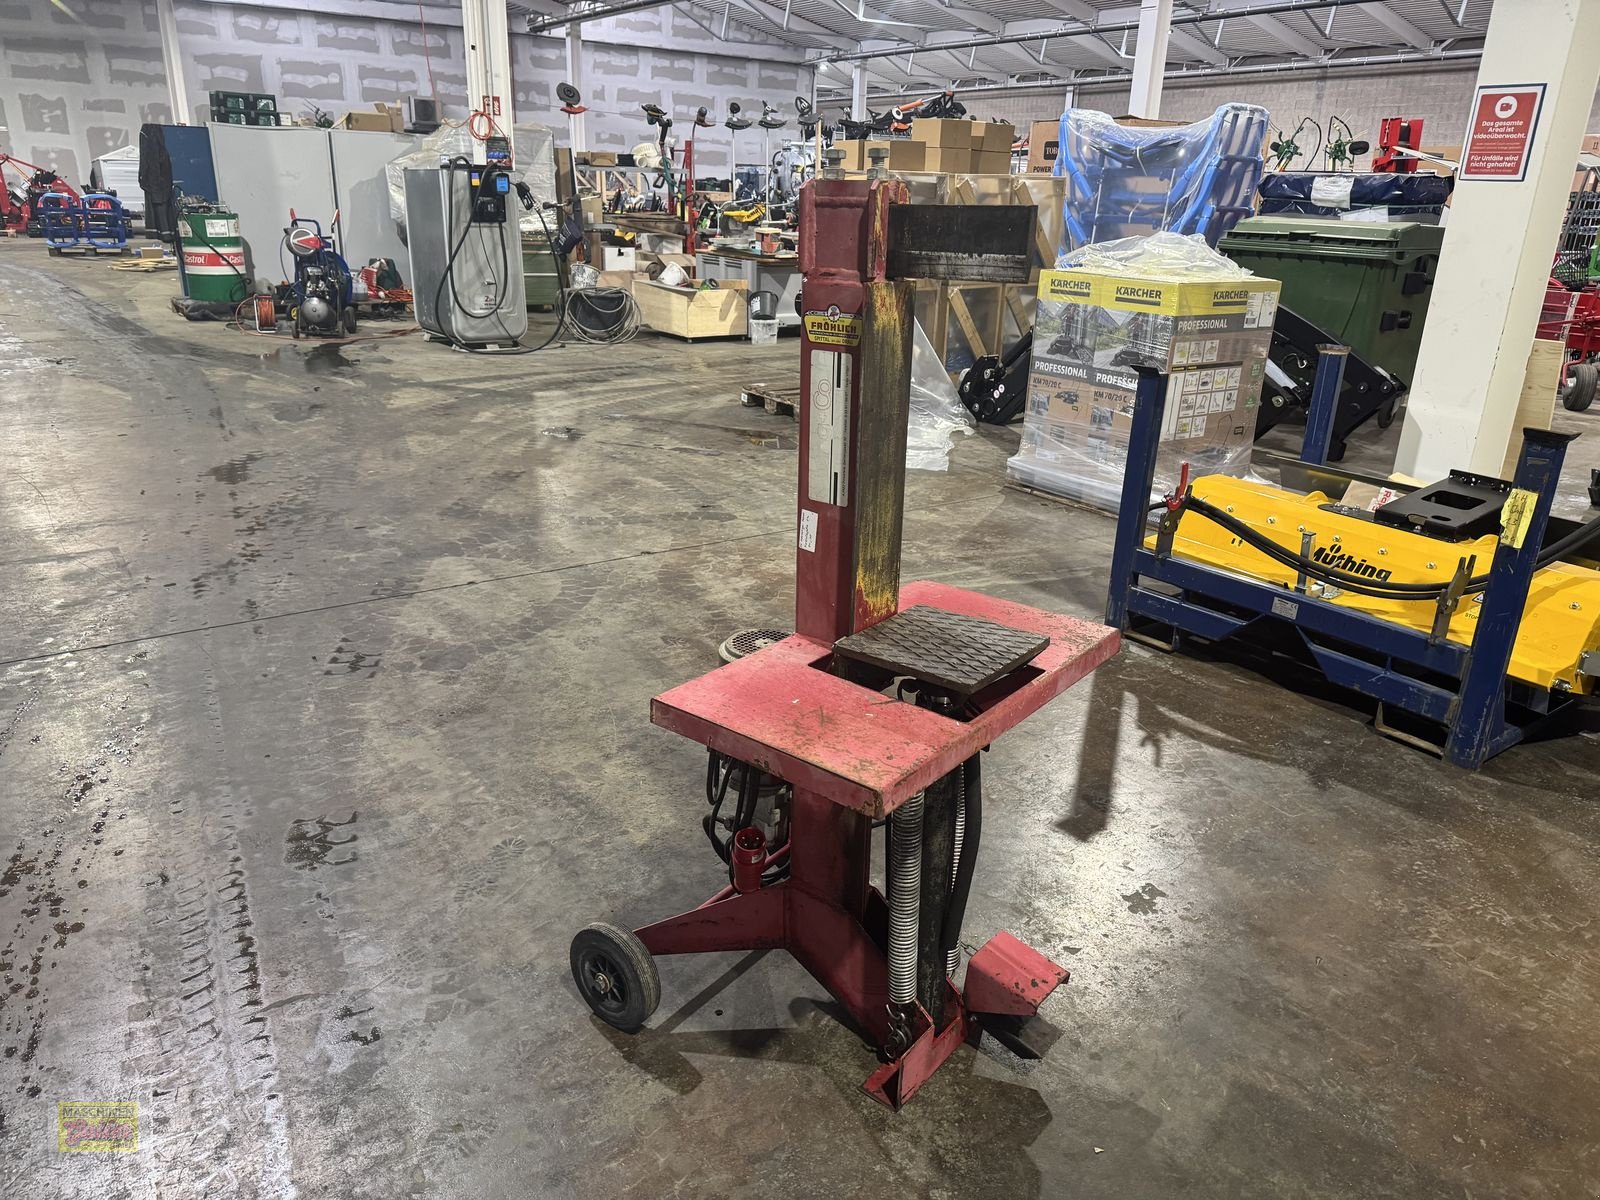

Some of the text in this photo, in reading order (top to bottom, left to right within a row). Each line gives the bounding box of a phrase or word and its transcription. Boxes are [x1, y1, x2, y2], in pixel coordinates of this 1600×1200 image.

[1046, 147, 1059, 155] TOR
[1050, 278, 1092, 291] KÄRCHER
[1115, 285, 1162, 299] KÄRCHER
[1213, 290, 1249, 300] KÄRCHER
[810, 321, 857, 334] FRÖHLICH
[1177, 318, 1228, 331] PROFESSIONAL
[1034, 360, 1088, 379] PROFESSIONAL
[1032, 376, 1042, 385] KM
[1042, 378, 1058, 389] 70/20
[1093, 390, 1104, 398] KM
[1104, 391, 1122, 402] 70/20
[1123, 395, 1127, 403] C
